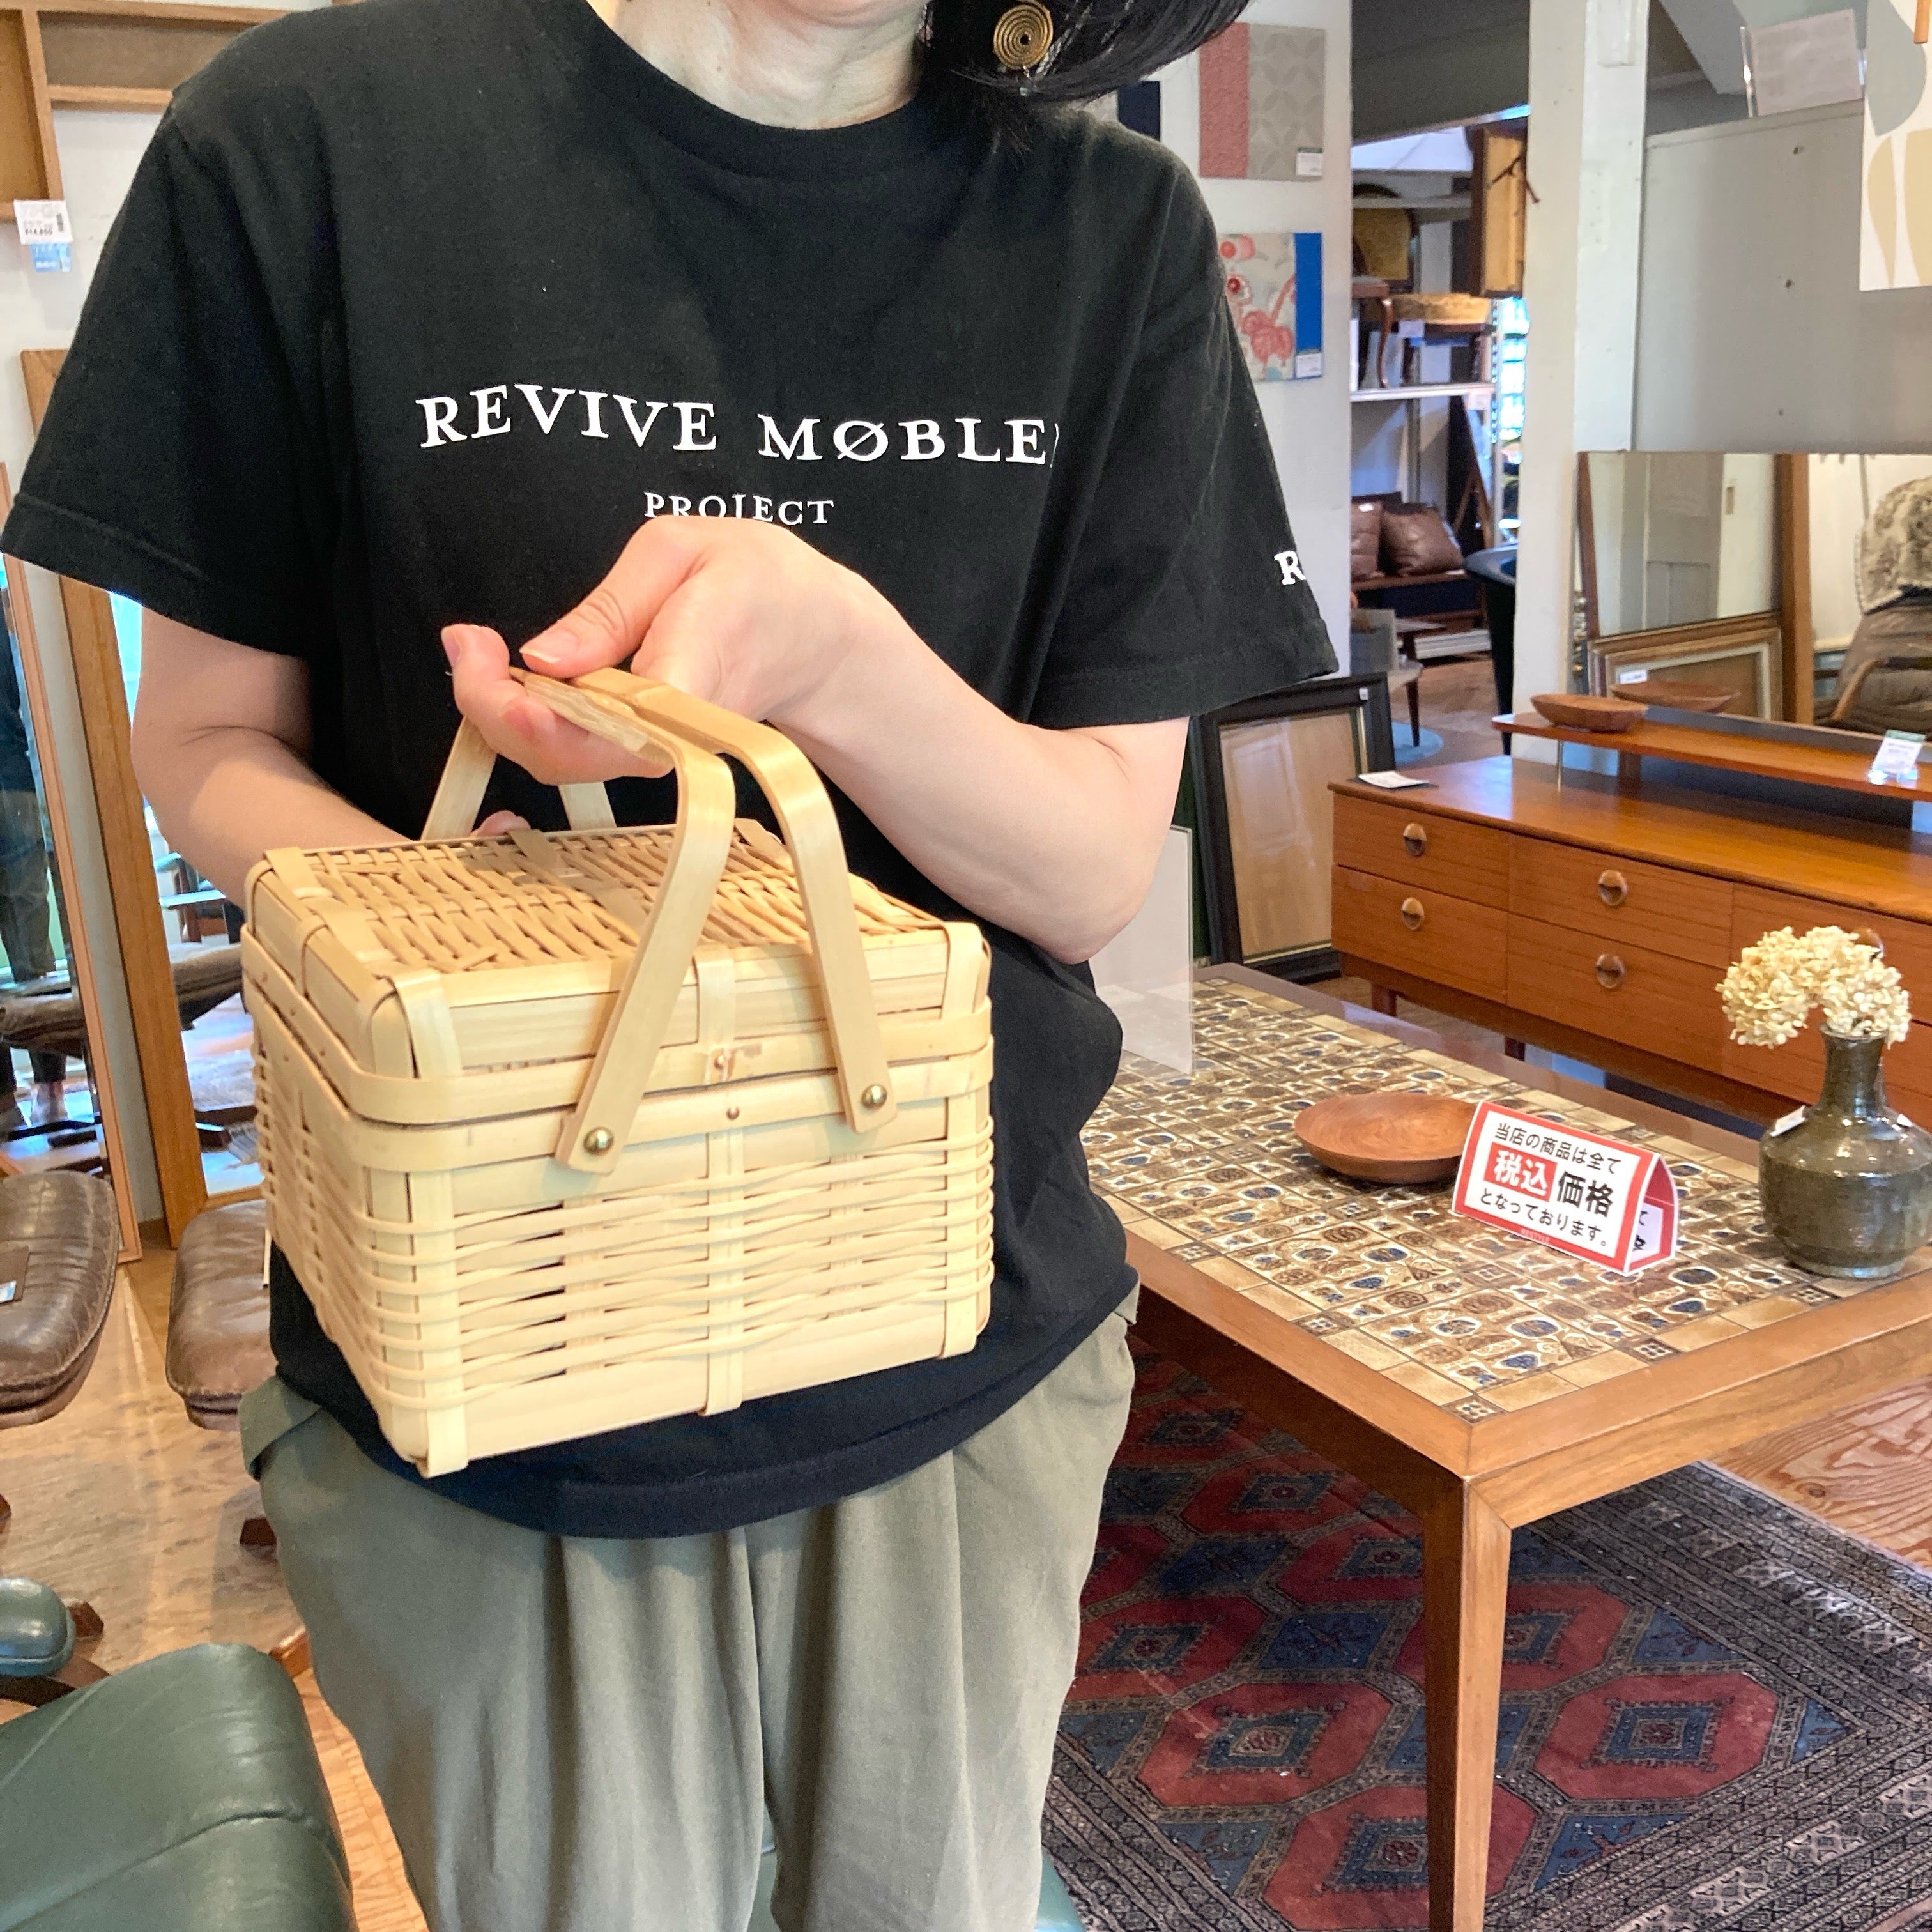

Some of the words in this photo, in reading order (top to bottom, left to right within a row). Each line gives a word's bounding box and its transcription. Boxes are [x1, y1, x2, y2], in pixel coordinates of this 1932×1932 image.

[415, 383, 717, 451] REVIVE
[756, 411, 1059, 468] MØBLE
[1494, 1123, 1621, 1174] 当店の商品は全て
